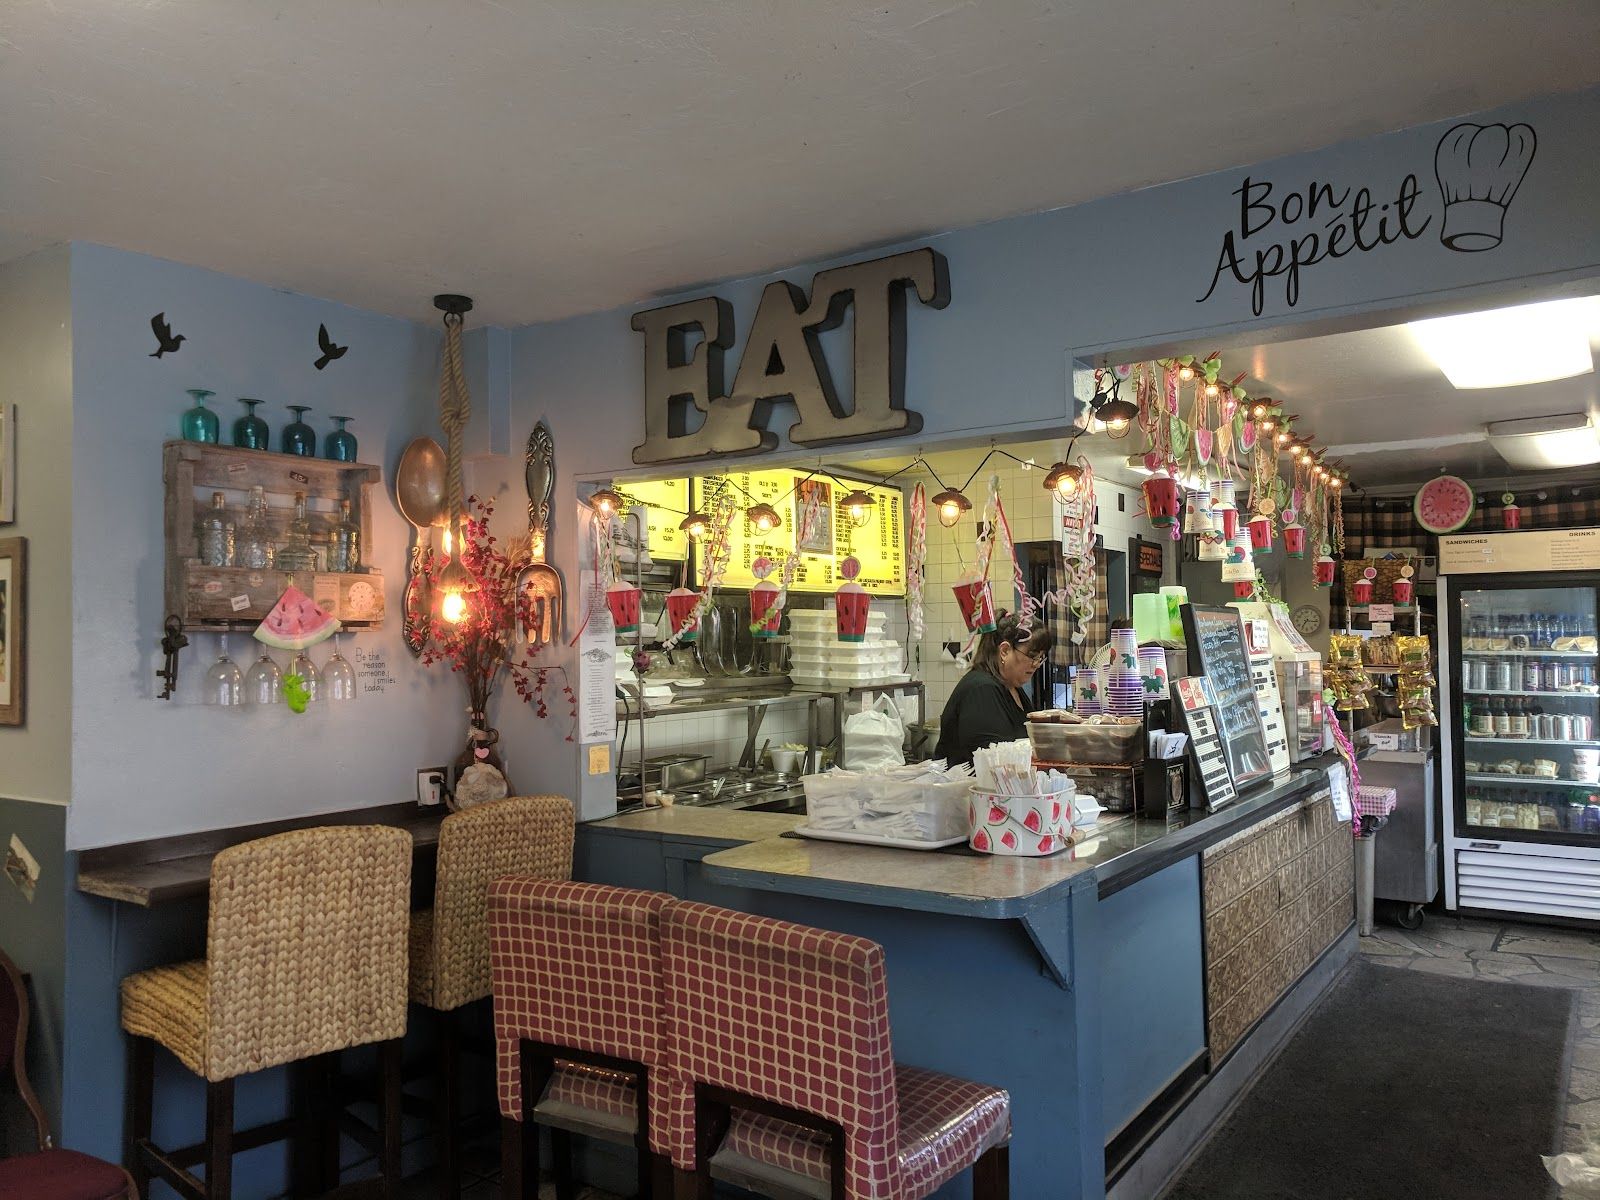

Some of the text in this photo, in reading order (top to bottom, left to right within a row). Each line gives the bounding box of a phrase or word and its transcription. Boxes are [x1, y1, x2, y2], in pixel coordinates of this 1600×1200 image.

[1232, 177, 1350, 239] Bon
[1196, 174, 1432, 316] Appétit
[631, 247, 951, 465] EAT
[355, 647, 381, 662] Be the
[364, 679, 385, 693] today
